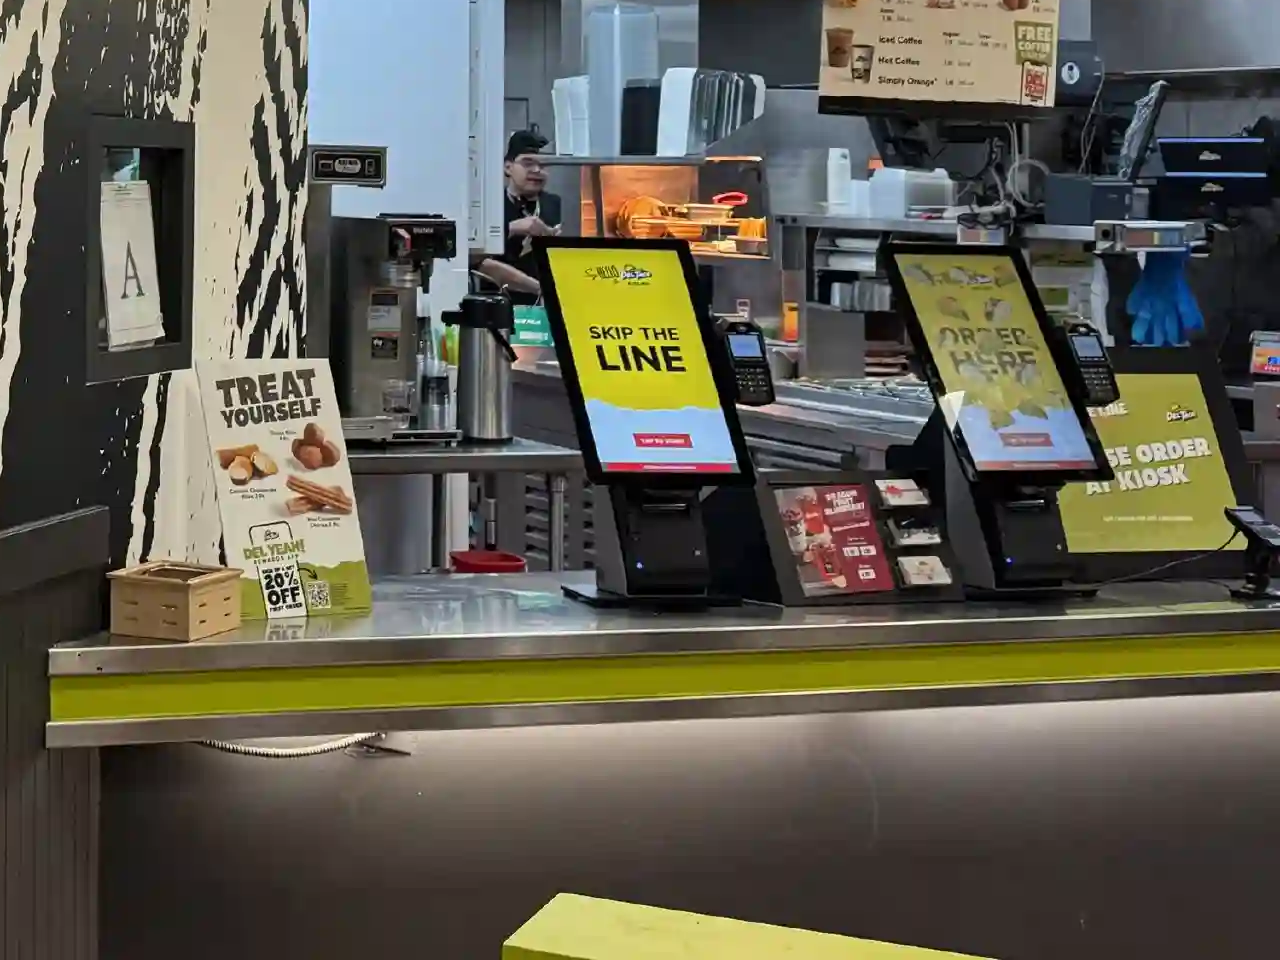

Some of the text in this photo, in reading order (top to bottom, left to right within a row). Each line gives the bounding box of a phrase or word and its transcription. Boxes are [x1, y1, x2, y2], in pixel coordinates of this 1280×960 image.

[879, 35, 923, 45] Iced Coffee
[1017, 25, 1053, 42] FREE
[878, 56, 920, 66] Hot Coffee
[878, 75, 906, 86] Simply
[120, 240, 145, 300] A
[588, 325, 680, 341] SKIP THE
[938, 326, 1030, 346] ORER
[595, 344, 687, 373] LINE
[215, 368, 316, 409] TREAT
[220, 398, 323, 429] YOURSELF
[1135, 437, 1213, 464] ORDER
[1115, 463, 1192, 492] KIOSK
[243, 538, 306, 561] DEL YEAH!
[264, 570, 299, 591] 20%
[267, 585, 300, 606] OFF
